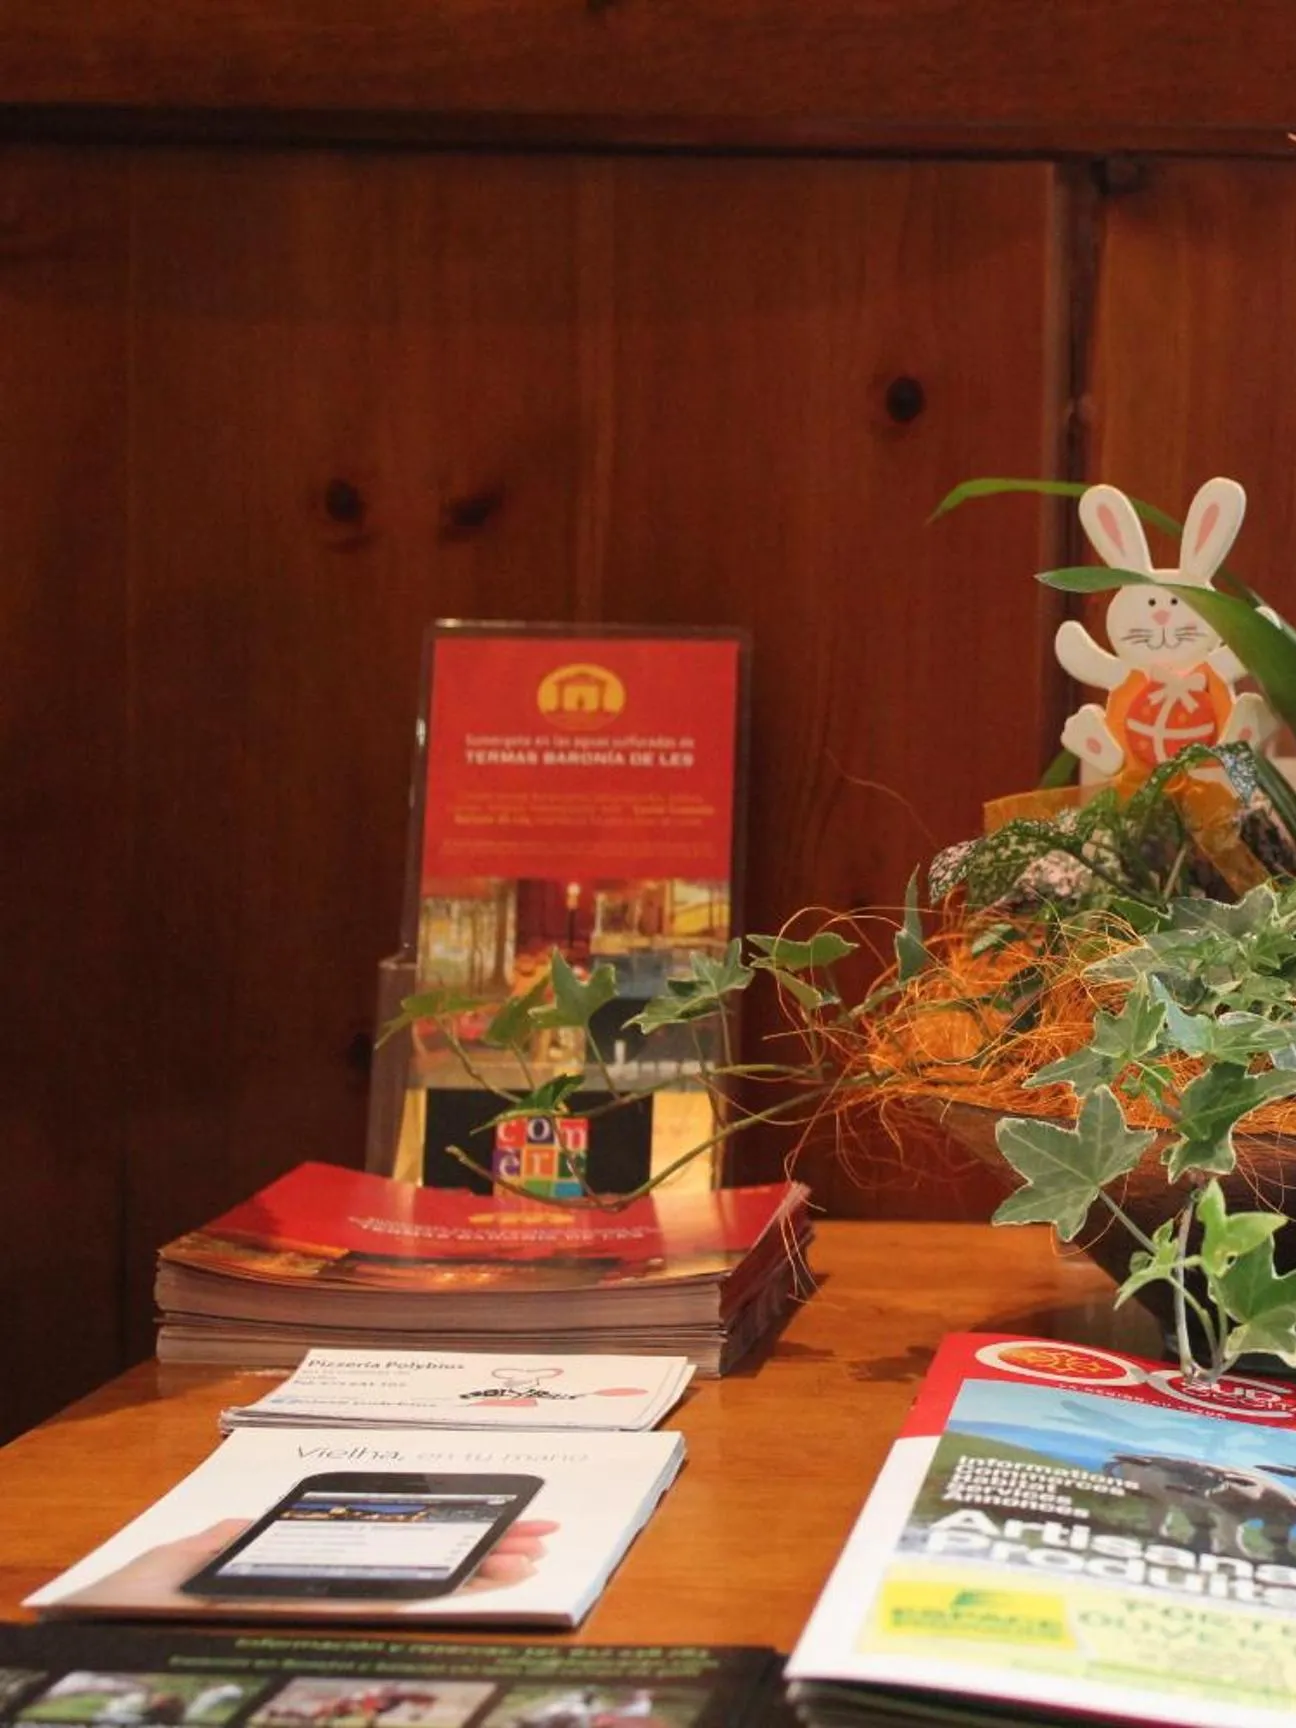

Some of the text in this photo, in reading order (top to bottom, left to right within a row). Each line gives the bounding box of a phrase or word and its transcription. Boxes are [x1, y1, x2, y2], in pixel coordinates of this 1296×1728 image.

[466, 750, 538, 765] TERMAS
[630, 752, 654, 767] DE
[659, 752, 694, 767] LES
[417, 1451, 455, 1462] en
[502, 1451, 589, 1463] mano
[951, 1474, 1057, 1493] Habitat
[955, 1464, 1126, 1497] Commerces
[958, 1455, 1140, 1491] Informations
[942, 1491, 1090, 1519] Annonces
[946, 1482, 1072, 1506] Services
